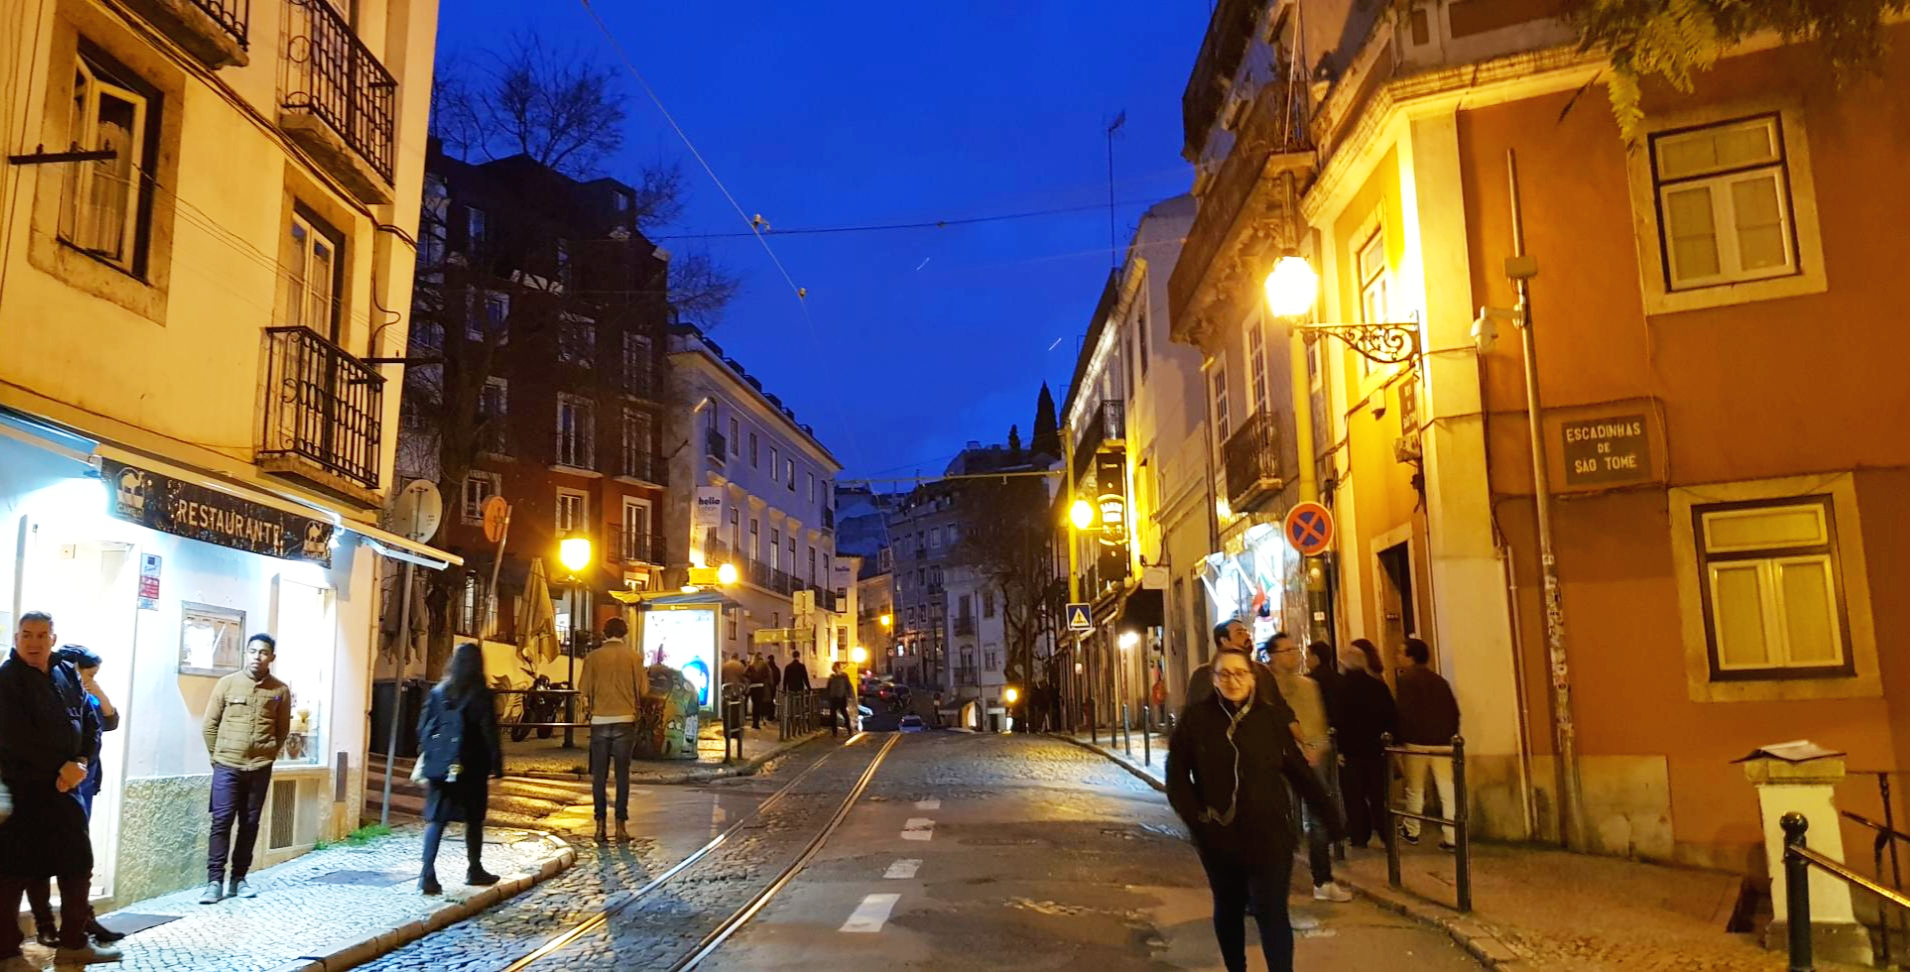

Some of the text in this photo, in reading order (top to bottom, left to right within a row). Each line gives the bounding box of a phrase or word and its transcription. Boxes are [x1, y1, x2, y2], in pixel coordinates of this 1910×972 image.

[1566, 422, 1641, 442] ESCADINHAS
[1597, 442, 1611, 454] DE
[178, 499, 281, 544] RESTAURANTE
